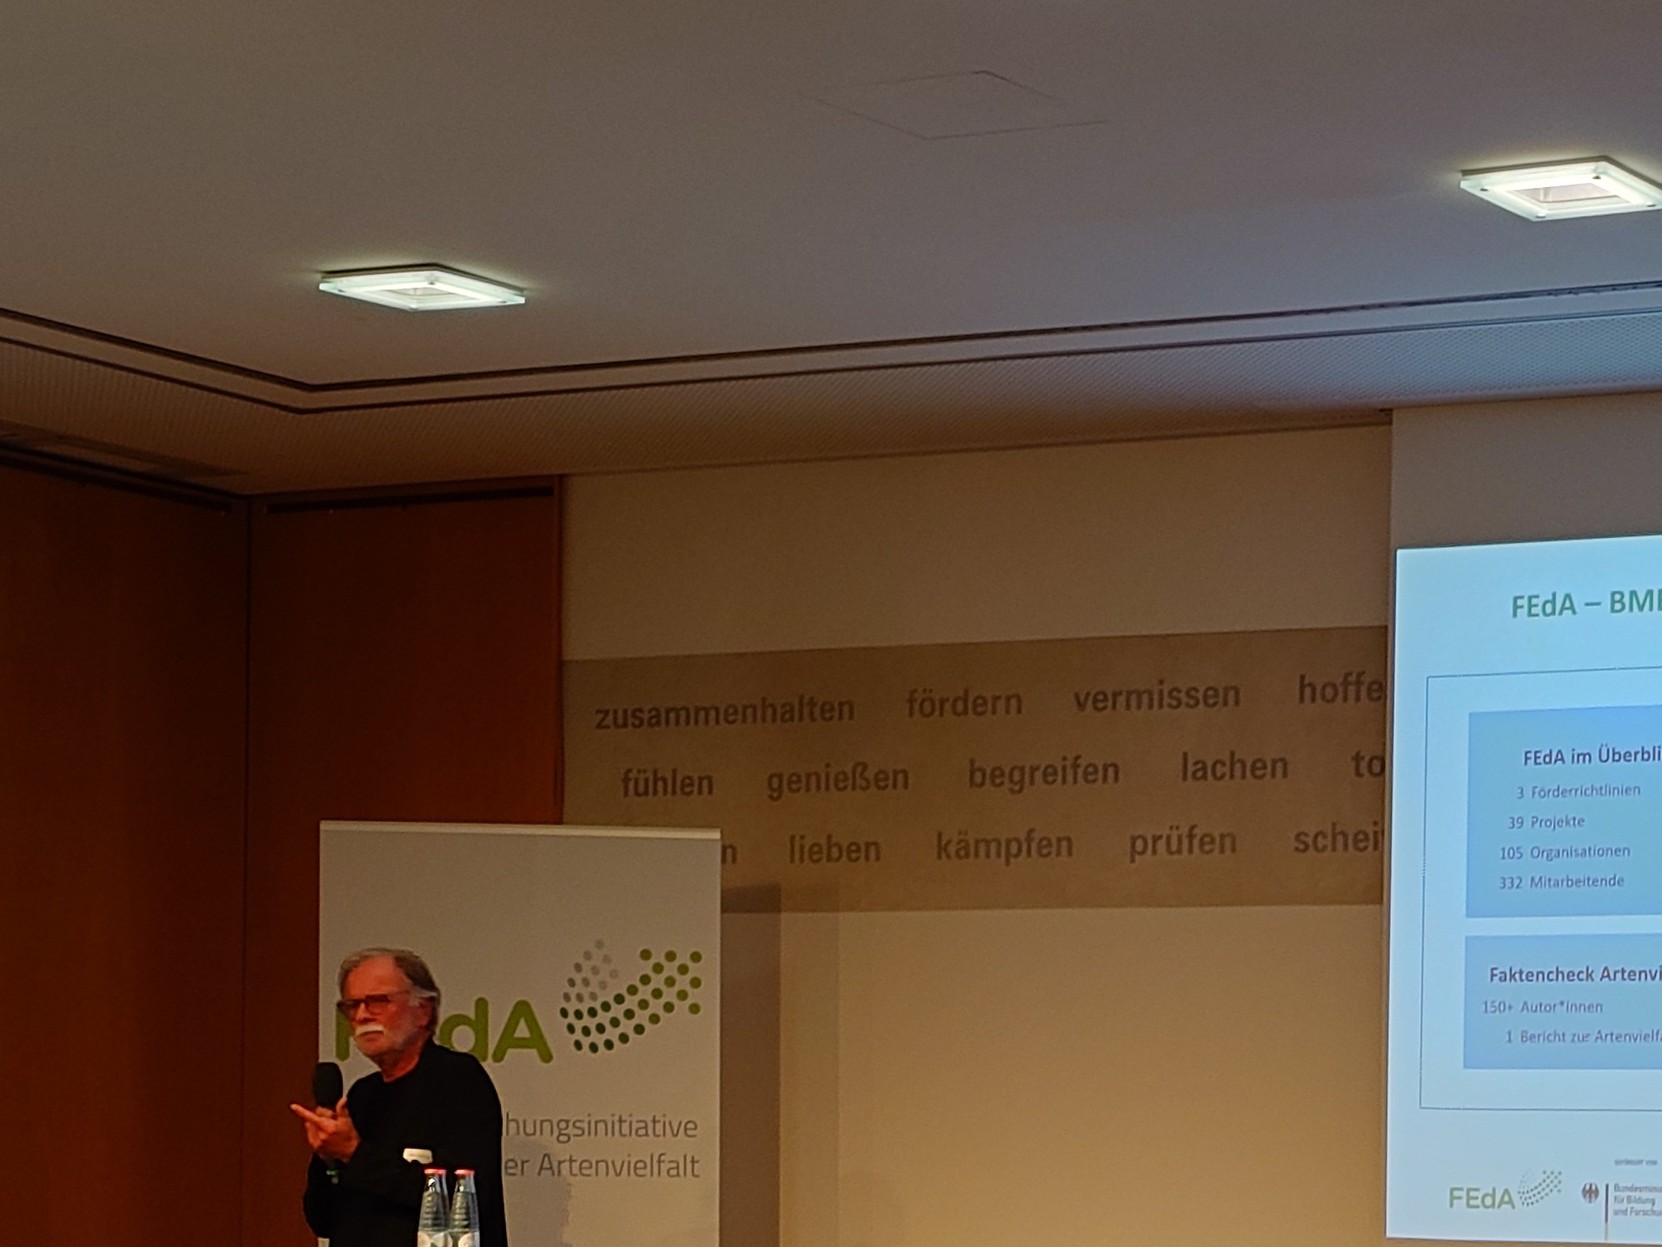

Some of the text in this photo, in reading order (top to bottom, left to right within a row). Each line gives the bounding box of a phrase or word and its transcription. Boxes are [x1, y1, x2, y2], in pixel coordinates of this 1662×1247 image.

[1511, 591, 1577, 618] FEdA
[595, 694, 855, 730] zusammenhalten
[907, 687, 1023, 719] fördern
[1073, 680, 1241, 713] vermissen
[1524, 748, 1566, 767] FEdA
[1571, 748, 1592, 765] im
[622, 768, 714, 798] fühlen
[767, 761, 909, 801] genießen
[968, 755, 1120, 795] begreifen
[1181, 750, 1288, 783] lachen
[1516, 786, 1525, 800] 3
[1507, 814, 1586, 832] 39 Projekte
[789, 833, 881, 865] lieben
[936, 828, 1074, 867] kämpfen
[1129, 824, 1237, 864] prüfen
[1293, 821, 1386, 854] schei
[1499, 844, 1631, 862] 105 Organisationen
[1499, 874, 1625, 890] 332 Mitarbeitende
[1489, 966, 1595, 984] Faktencheck
[1483, 1000, 1514, 1014] 150+
[335, 996, 554, 1064] dA
[1505, 1030, 1513, 1044] 1
[1520, 1029, 1566, 1044] Bericht
[1570, 1032, 1591, 1044] zur
[537, 1152, 700, 1179] Artenvielfalt
[1449, 1186, 1516, 1210] FEdA
